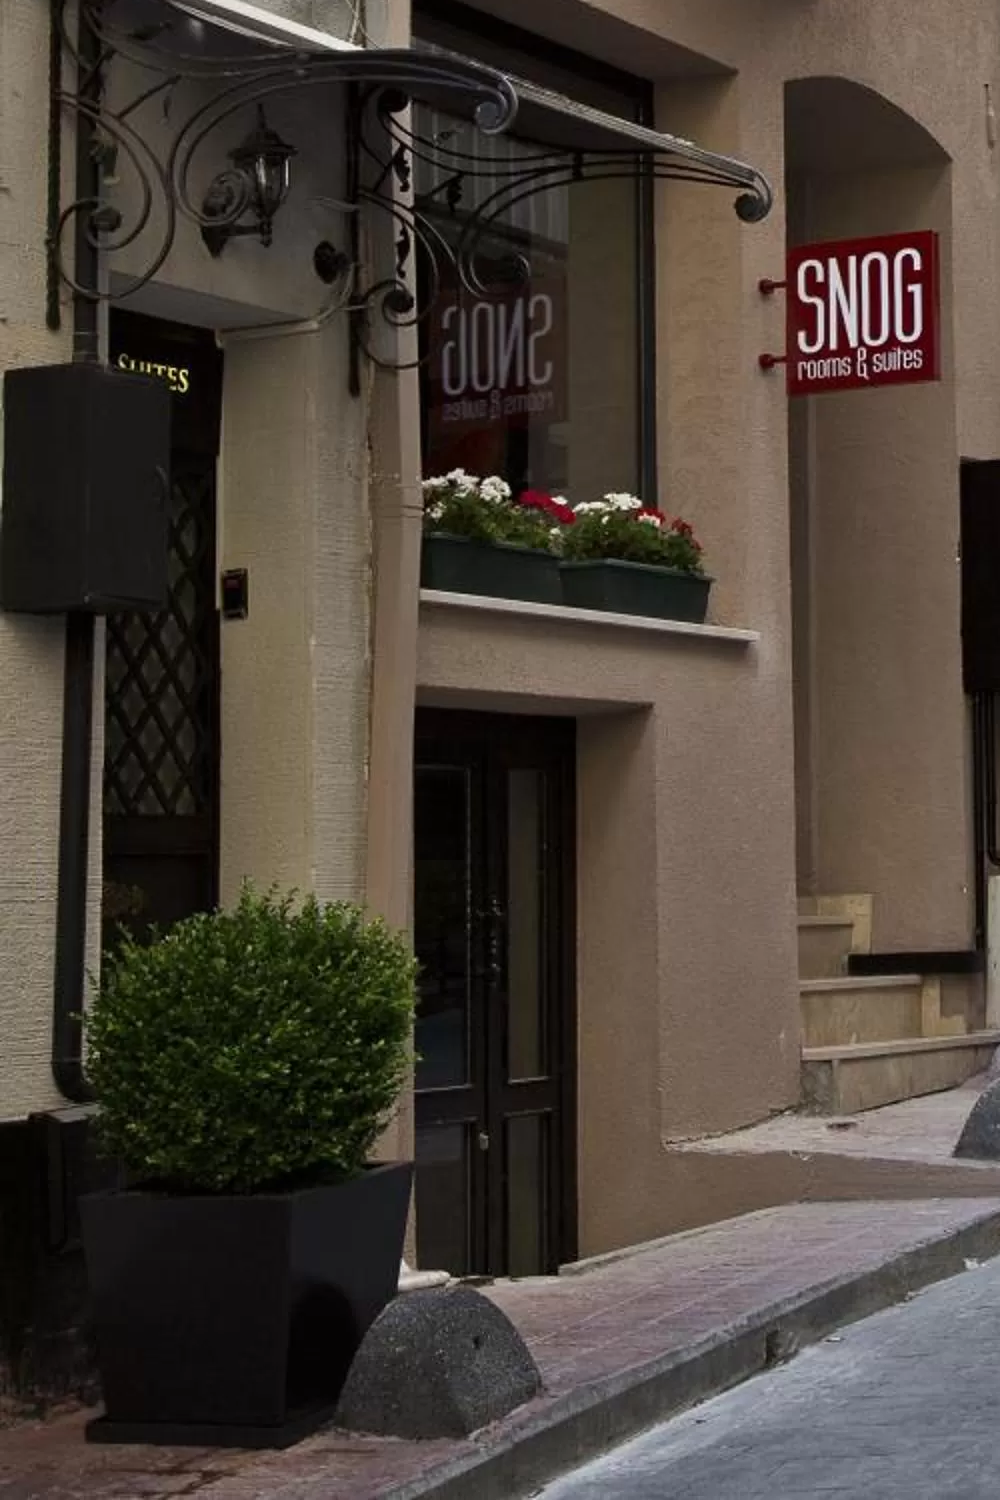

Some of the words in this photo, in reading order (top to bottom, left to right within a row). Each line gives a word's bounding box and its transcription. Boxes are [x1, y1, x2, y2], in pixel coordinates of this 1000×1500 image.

[797, 247, 923, 354] SNOG
[798, 354, 851, 380] rooms
[856, 347, 869, 379] &
[873, 346, 923, 373] suites
